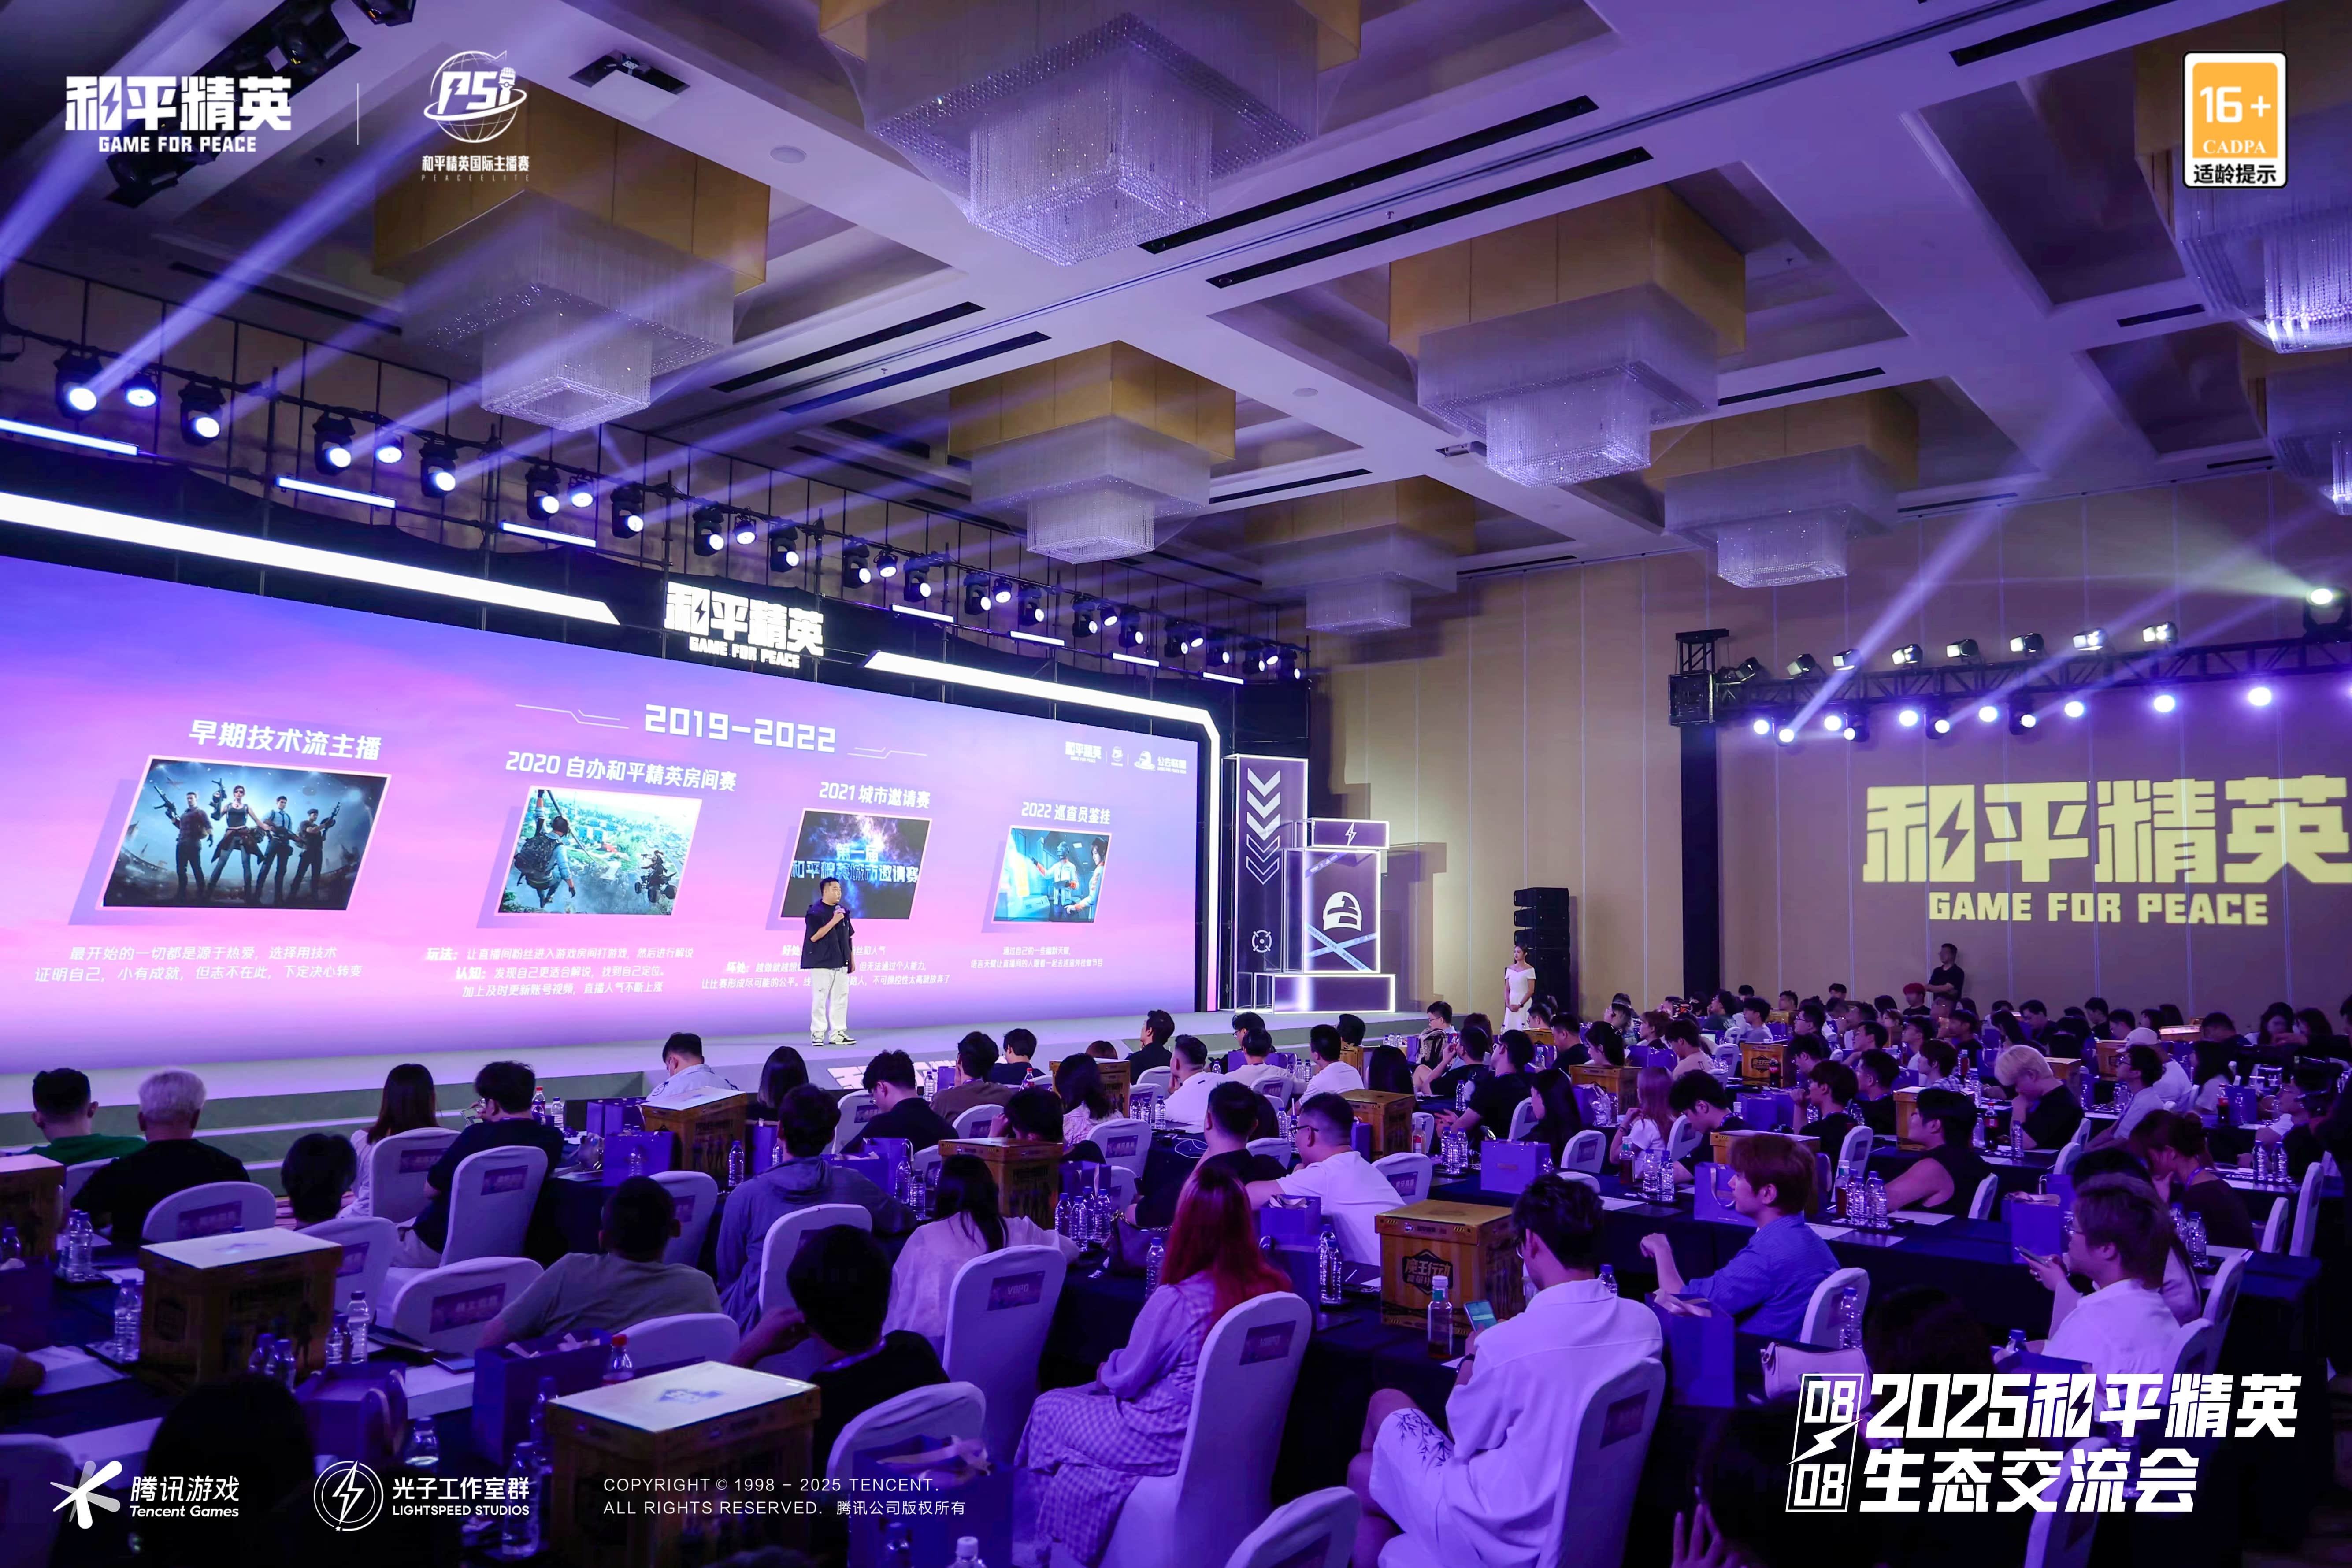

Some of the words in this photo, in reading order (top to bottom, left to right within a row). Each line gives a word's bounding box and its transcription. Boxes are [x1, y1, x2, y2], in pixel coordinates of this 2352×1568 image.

[664, 581, 824, 656] 和平精英
[689, 636, 728, 656] GAME
[731, 643, 757, 661] FOR
[761, 649, 800, 669] PEACE
[189, 719, 382, 760] 早期技术流主播
[645, 704, 836, 753] 2019-2022
[505, 751, 561, 775] 2020
[566, 756, 738, 791] 自办和平精英房间赛
[819, 782, 856, 801] 2021
[859, 785, 931, 809] 城市邀请赛
[1021, 801, 1052, 818] 2022
[1054, 804, 1111, 825] 巡查员鉴挂
[1862, 775, 2352, 884] 和平精英
[836, 843, 879, 862] 第一届
[1929, 892, 2031, 921] GAME
[2048, 892, 2121, 923] FOR
[2138, 893, 2268, 924] PEACE
